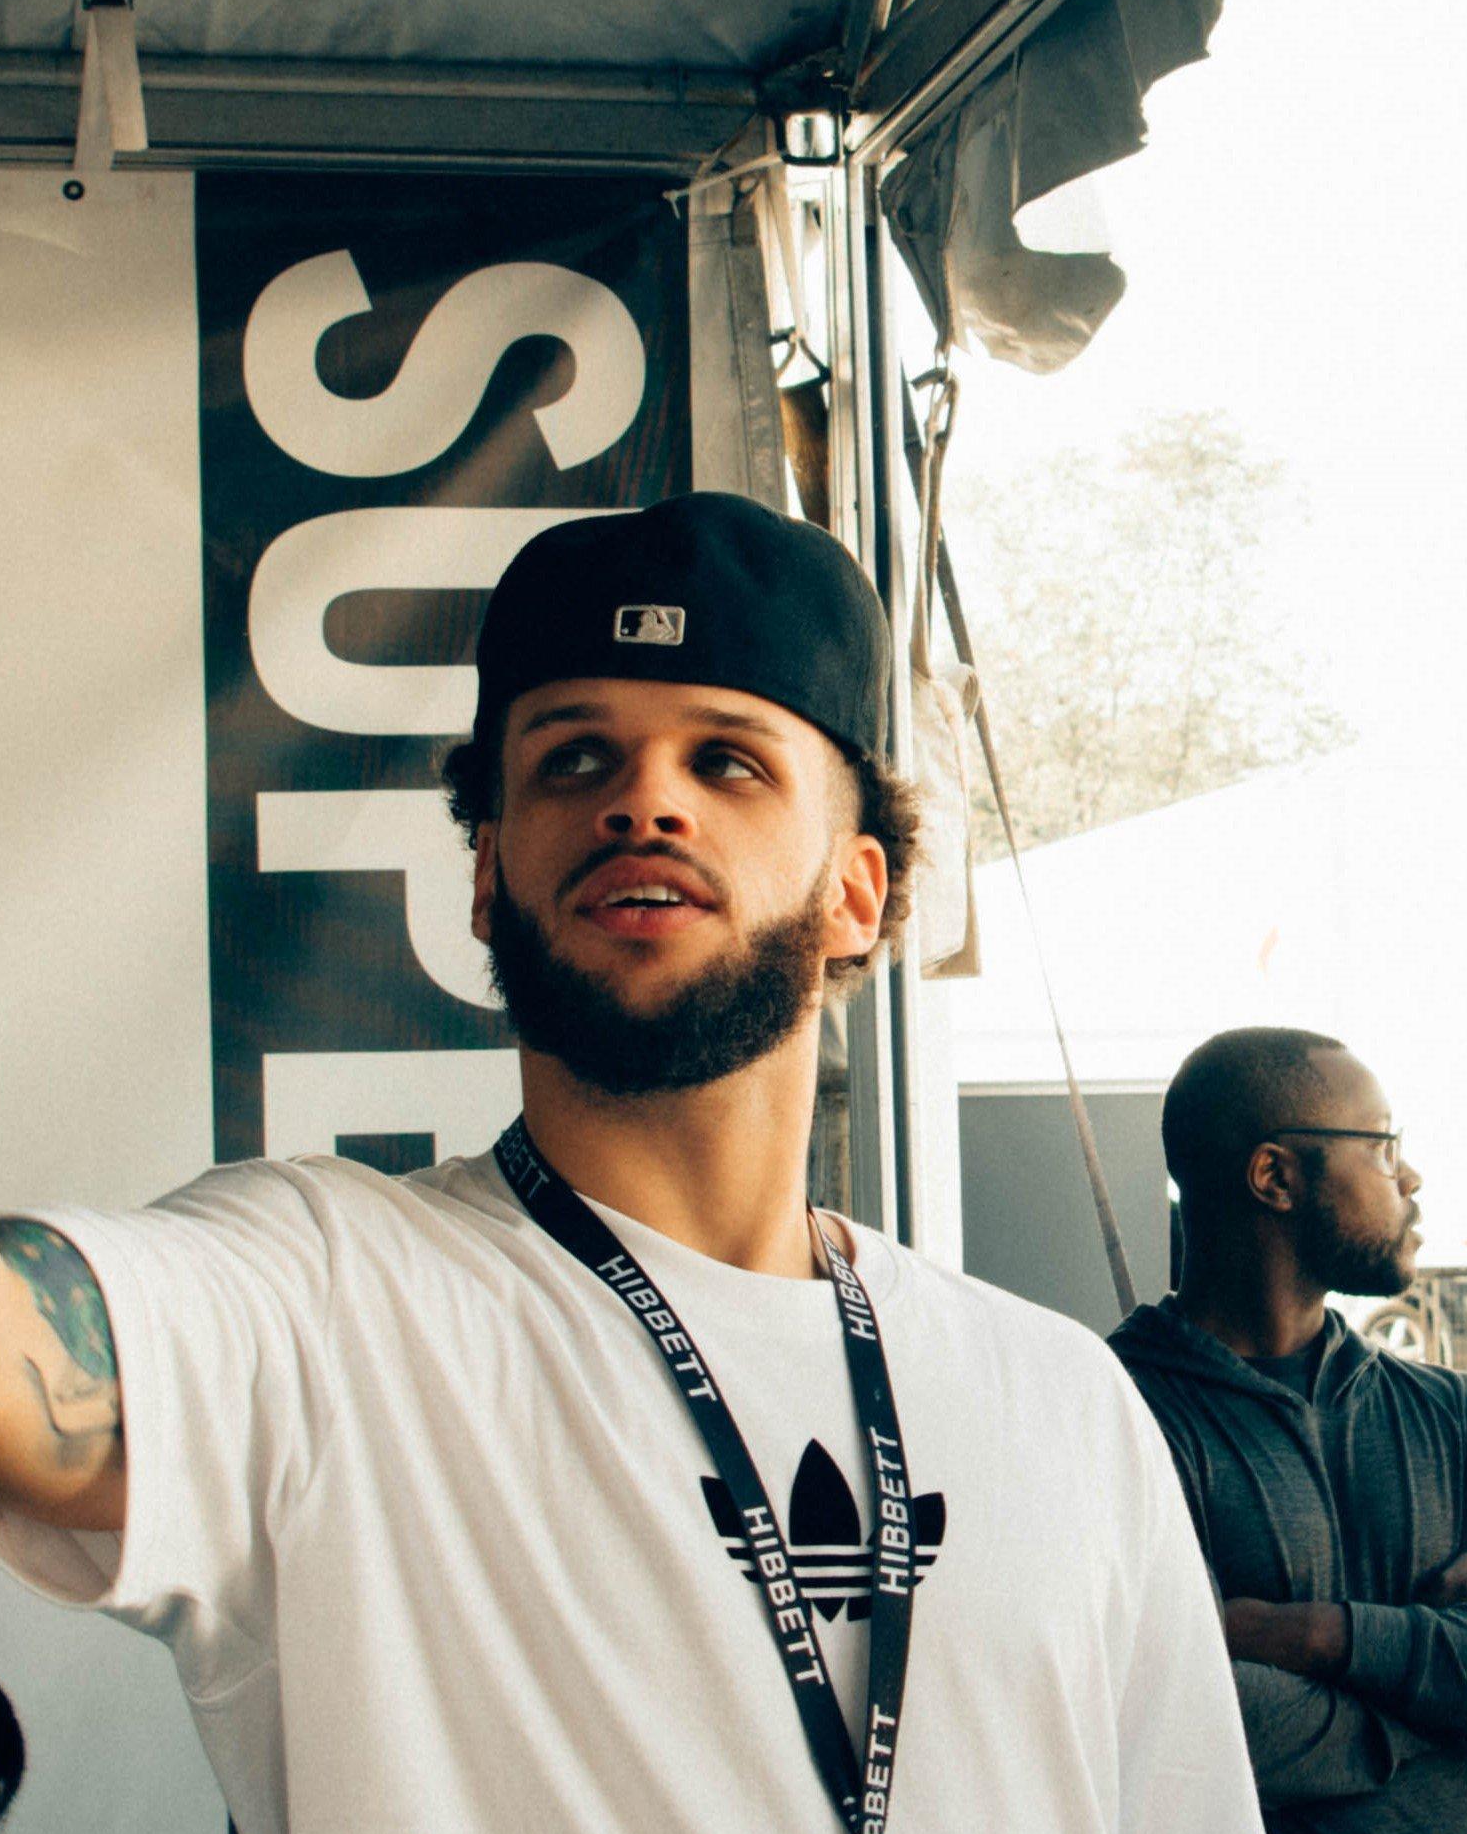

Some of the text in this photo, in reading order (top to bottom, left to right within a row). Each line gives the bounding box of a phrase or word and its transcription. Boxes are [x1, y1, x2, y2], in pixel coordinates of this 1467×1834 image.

[598, 1253, 718, 1404] HIBBETT
[870, 1427, 913, 1595] HIBBETT
[743, 1506, 826, 1686] HIBBETT
